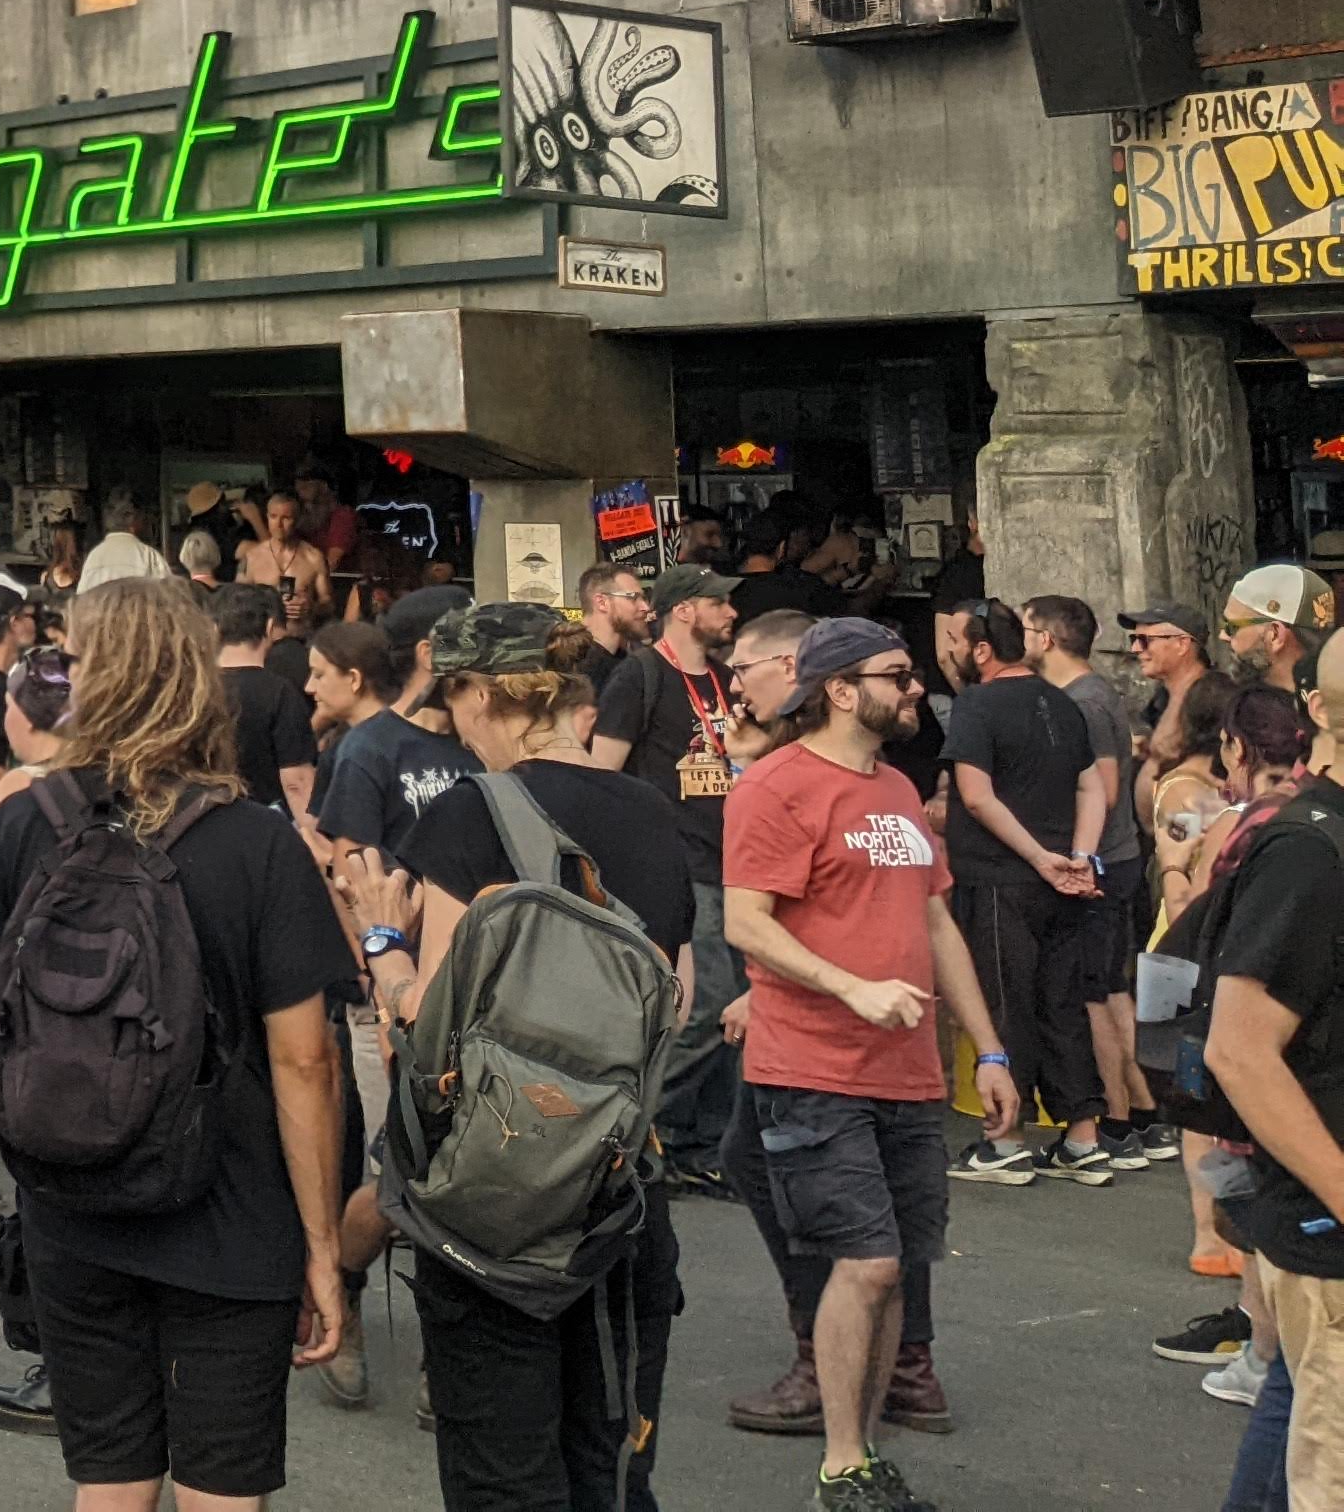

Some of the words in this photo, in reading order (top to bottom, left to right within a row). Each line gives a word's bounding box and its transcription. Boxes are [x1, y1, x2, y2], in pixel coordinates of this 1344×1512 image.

[1195, 87, 1289, 134] BANG!
[1126, 140, 1223, 251] BIG
[573, 263, 658, 288] KRAKEN
[690, 770, 722, 781] LET'S
[713, 782, 732, 793] DEA
[865, 814, 900, 832] THE
[843, 831, 907, 850] NORTH
[869, 848, 911, 867] FACE
